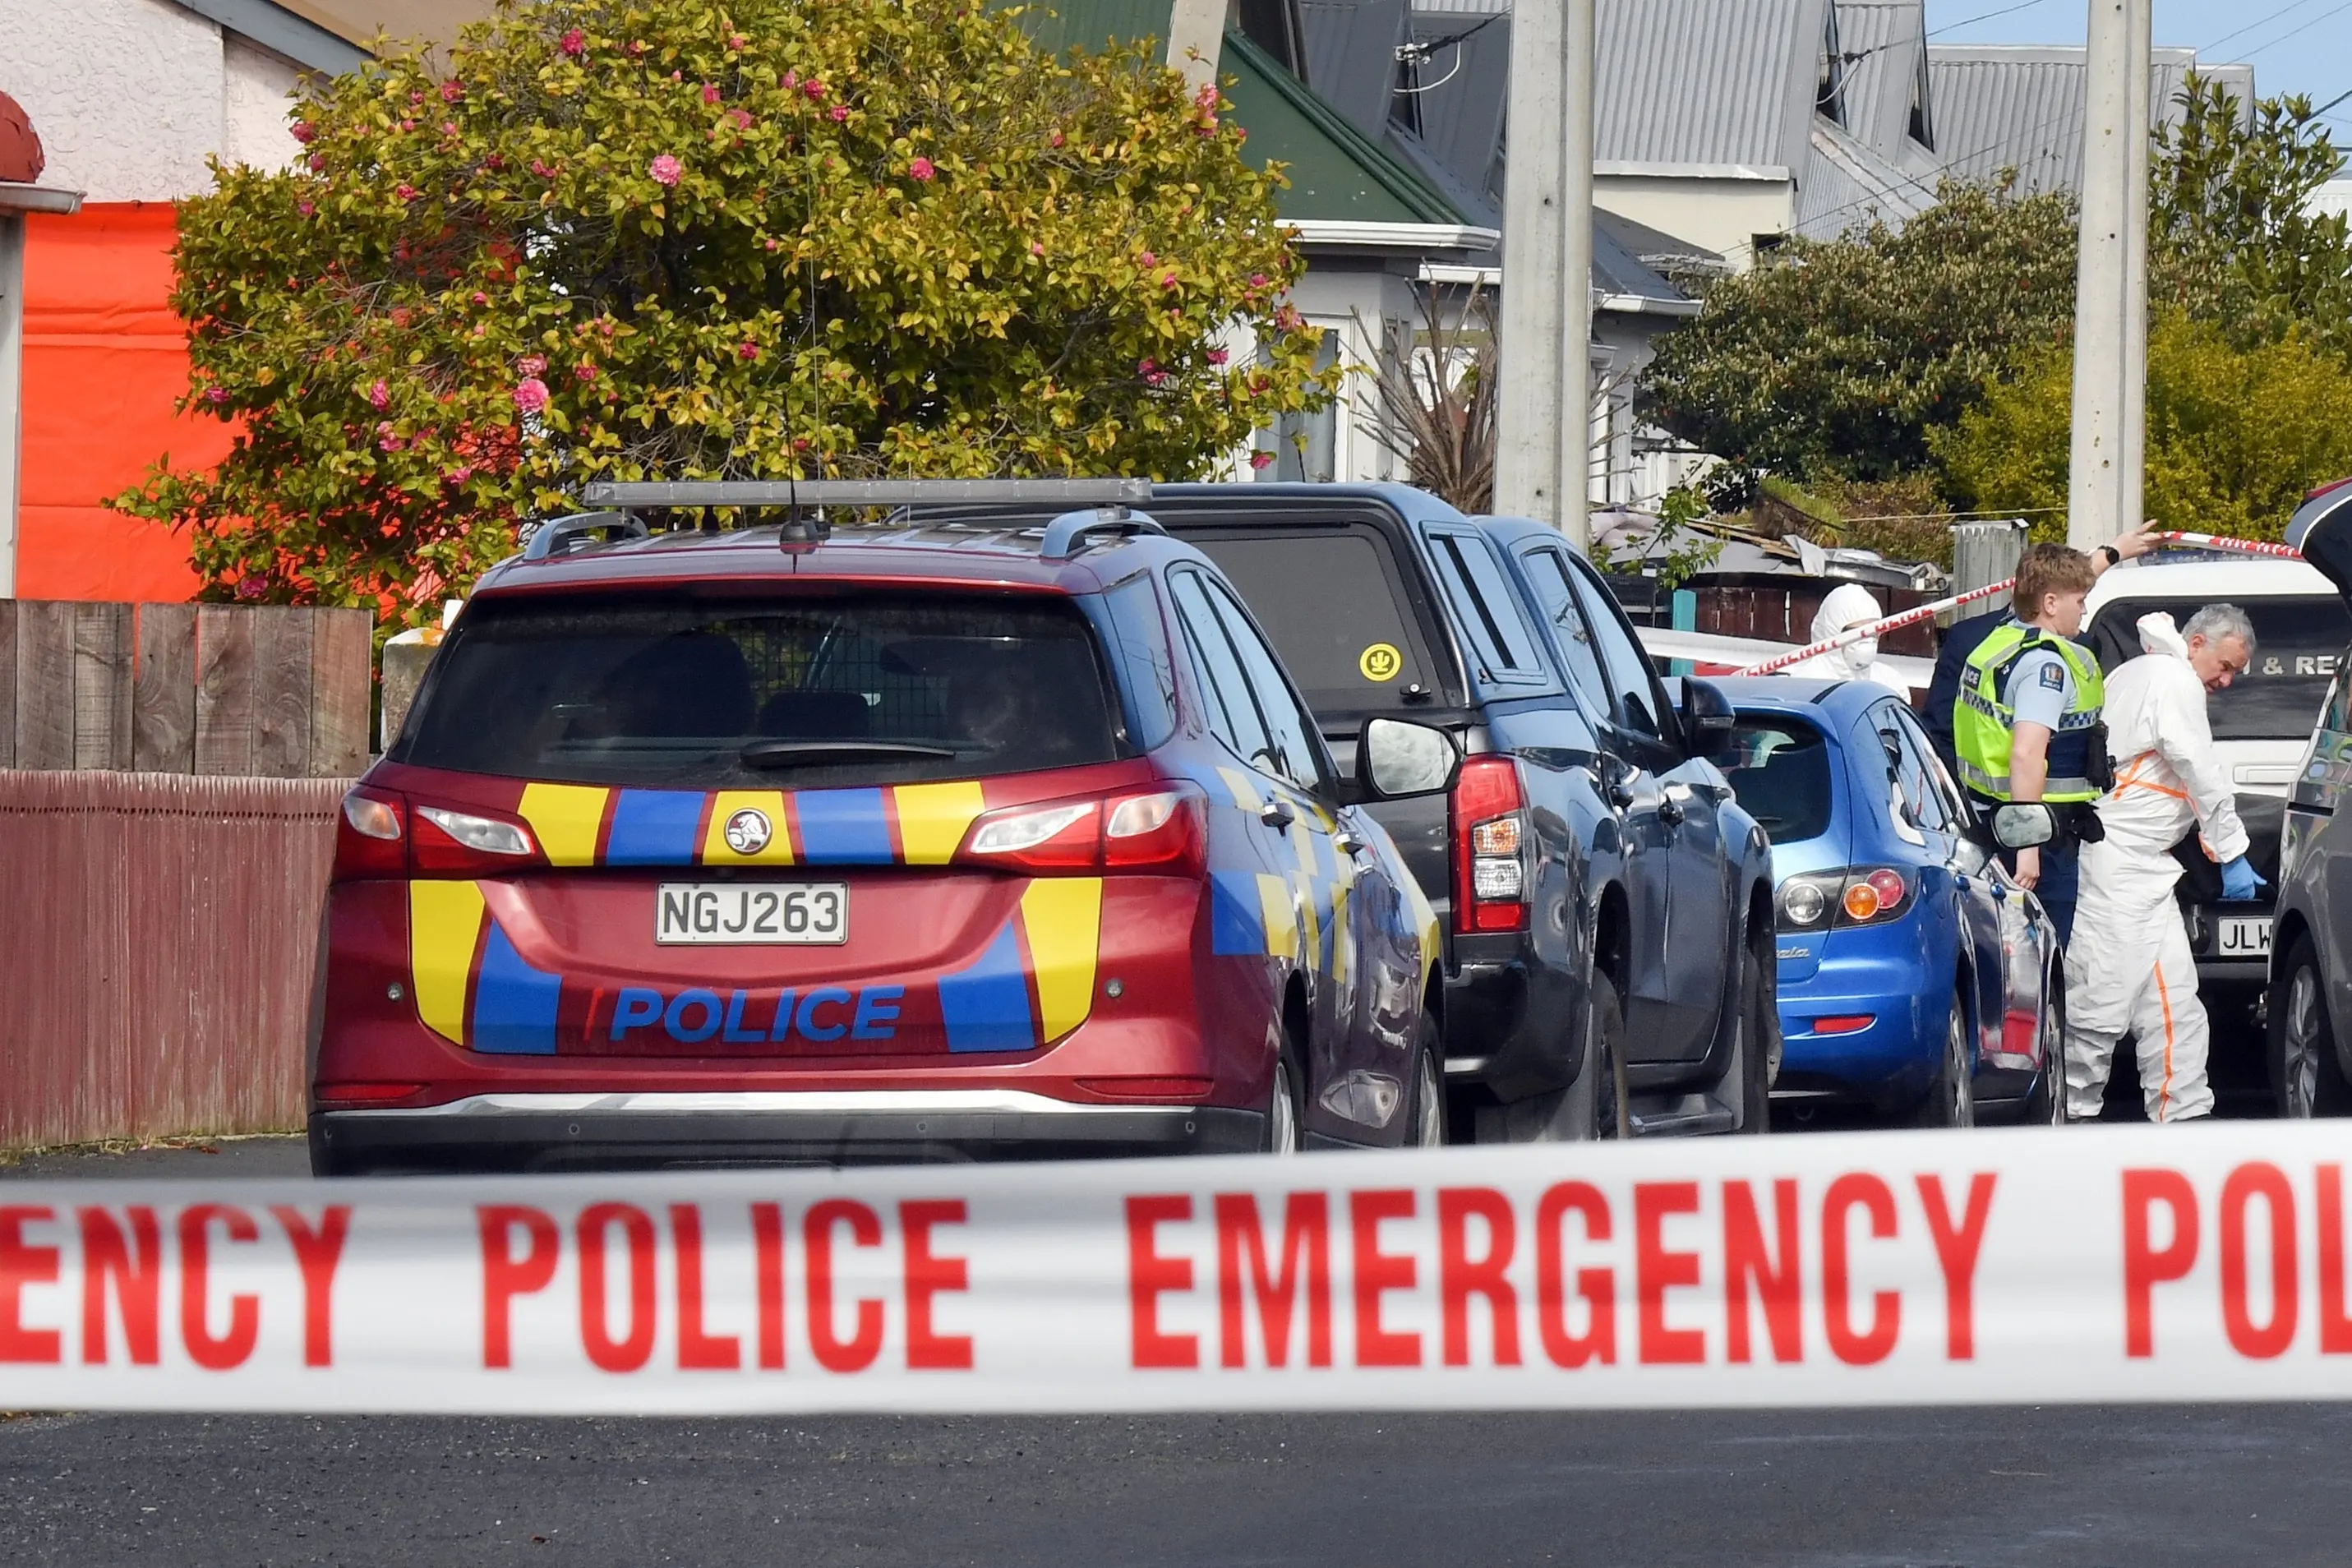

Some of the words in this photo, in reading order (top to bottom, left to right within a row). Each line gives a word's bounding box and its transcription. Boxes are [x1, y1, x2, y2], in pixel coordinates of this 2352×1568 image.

[2262, 656, 2285, 675] &
[663, 892, 838, 934] NGJ263
[610, 985, 906, 1044] POLICE
[477, 1199, 974, 1373] POLICE
[1126, 1172, 1997, 1370] EMERGENCY
